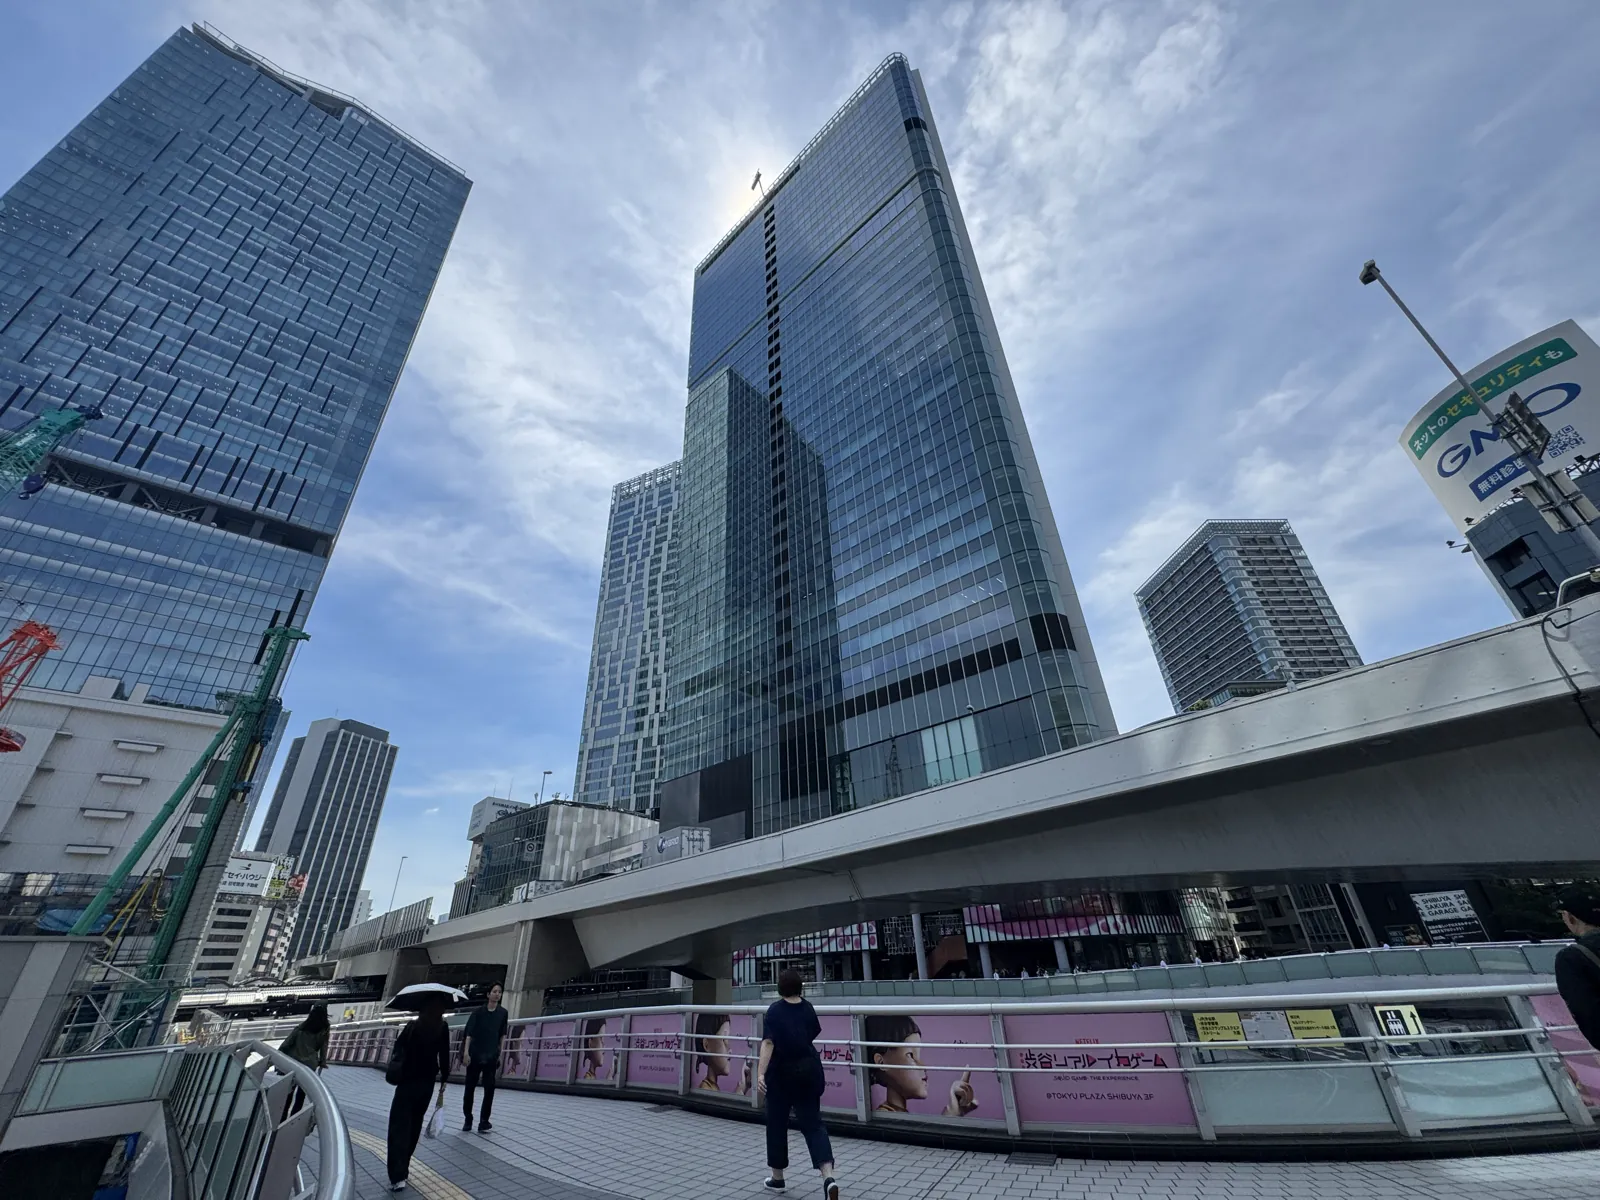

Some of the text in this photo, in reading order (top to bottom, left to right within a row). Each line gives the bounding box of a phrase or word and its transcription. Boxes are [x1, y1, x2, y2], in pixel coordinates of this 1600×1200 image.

[1413, 349, 1563, 452] ネットのセキュリティも
[1421, 895, 1452, 905] SHIBUYA
[1424, 901, 1455, 911] SAKURA
[1427, 907, 1459, 917] GARAGE
[1080, 1092, 1106, 1100] PLAZA
[1106, 1092, 1143, 1101] SHIBUYA
